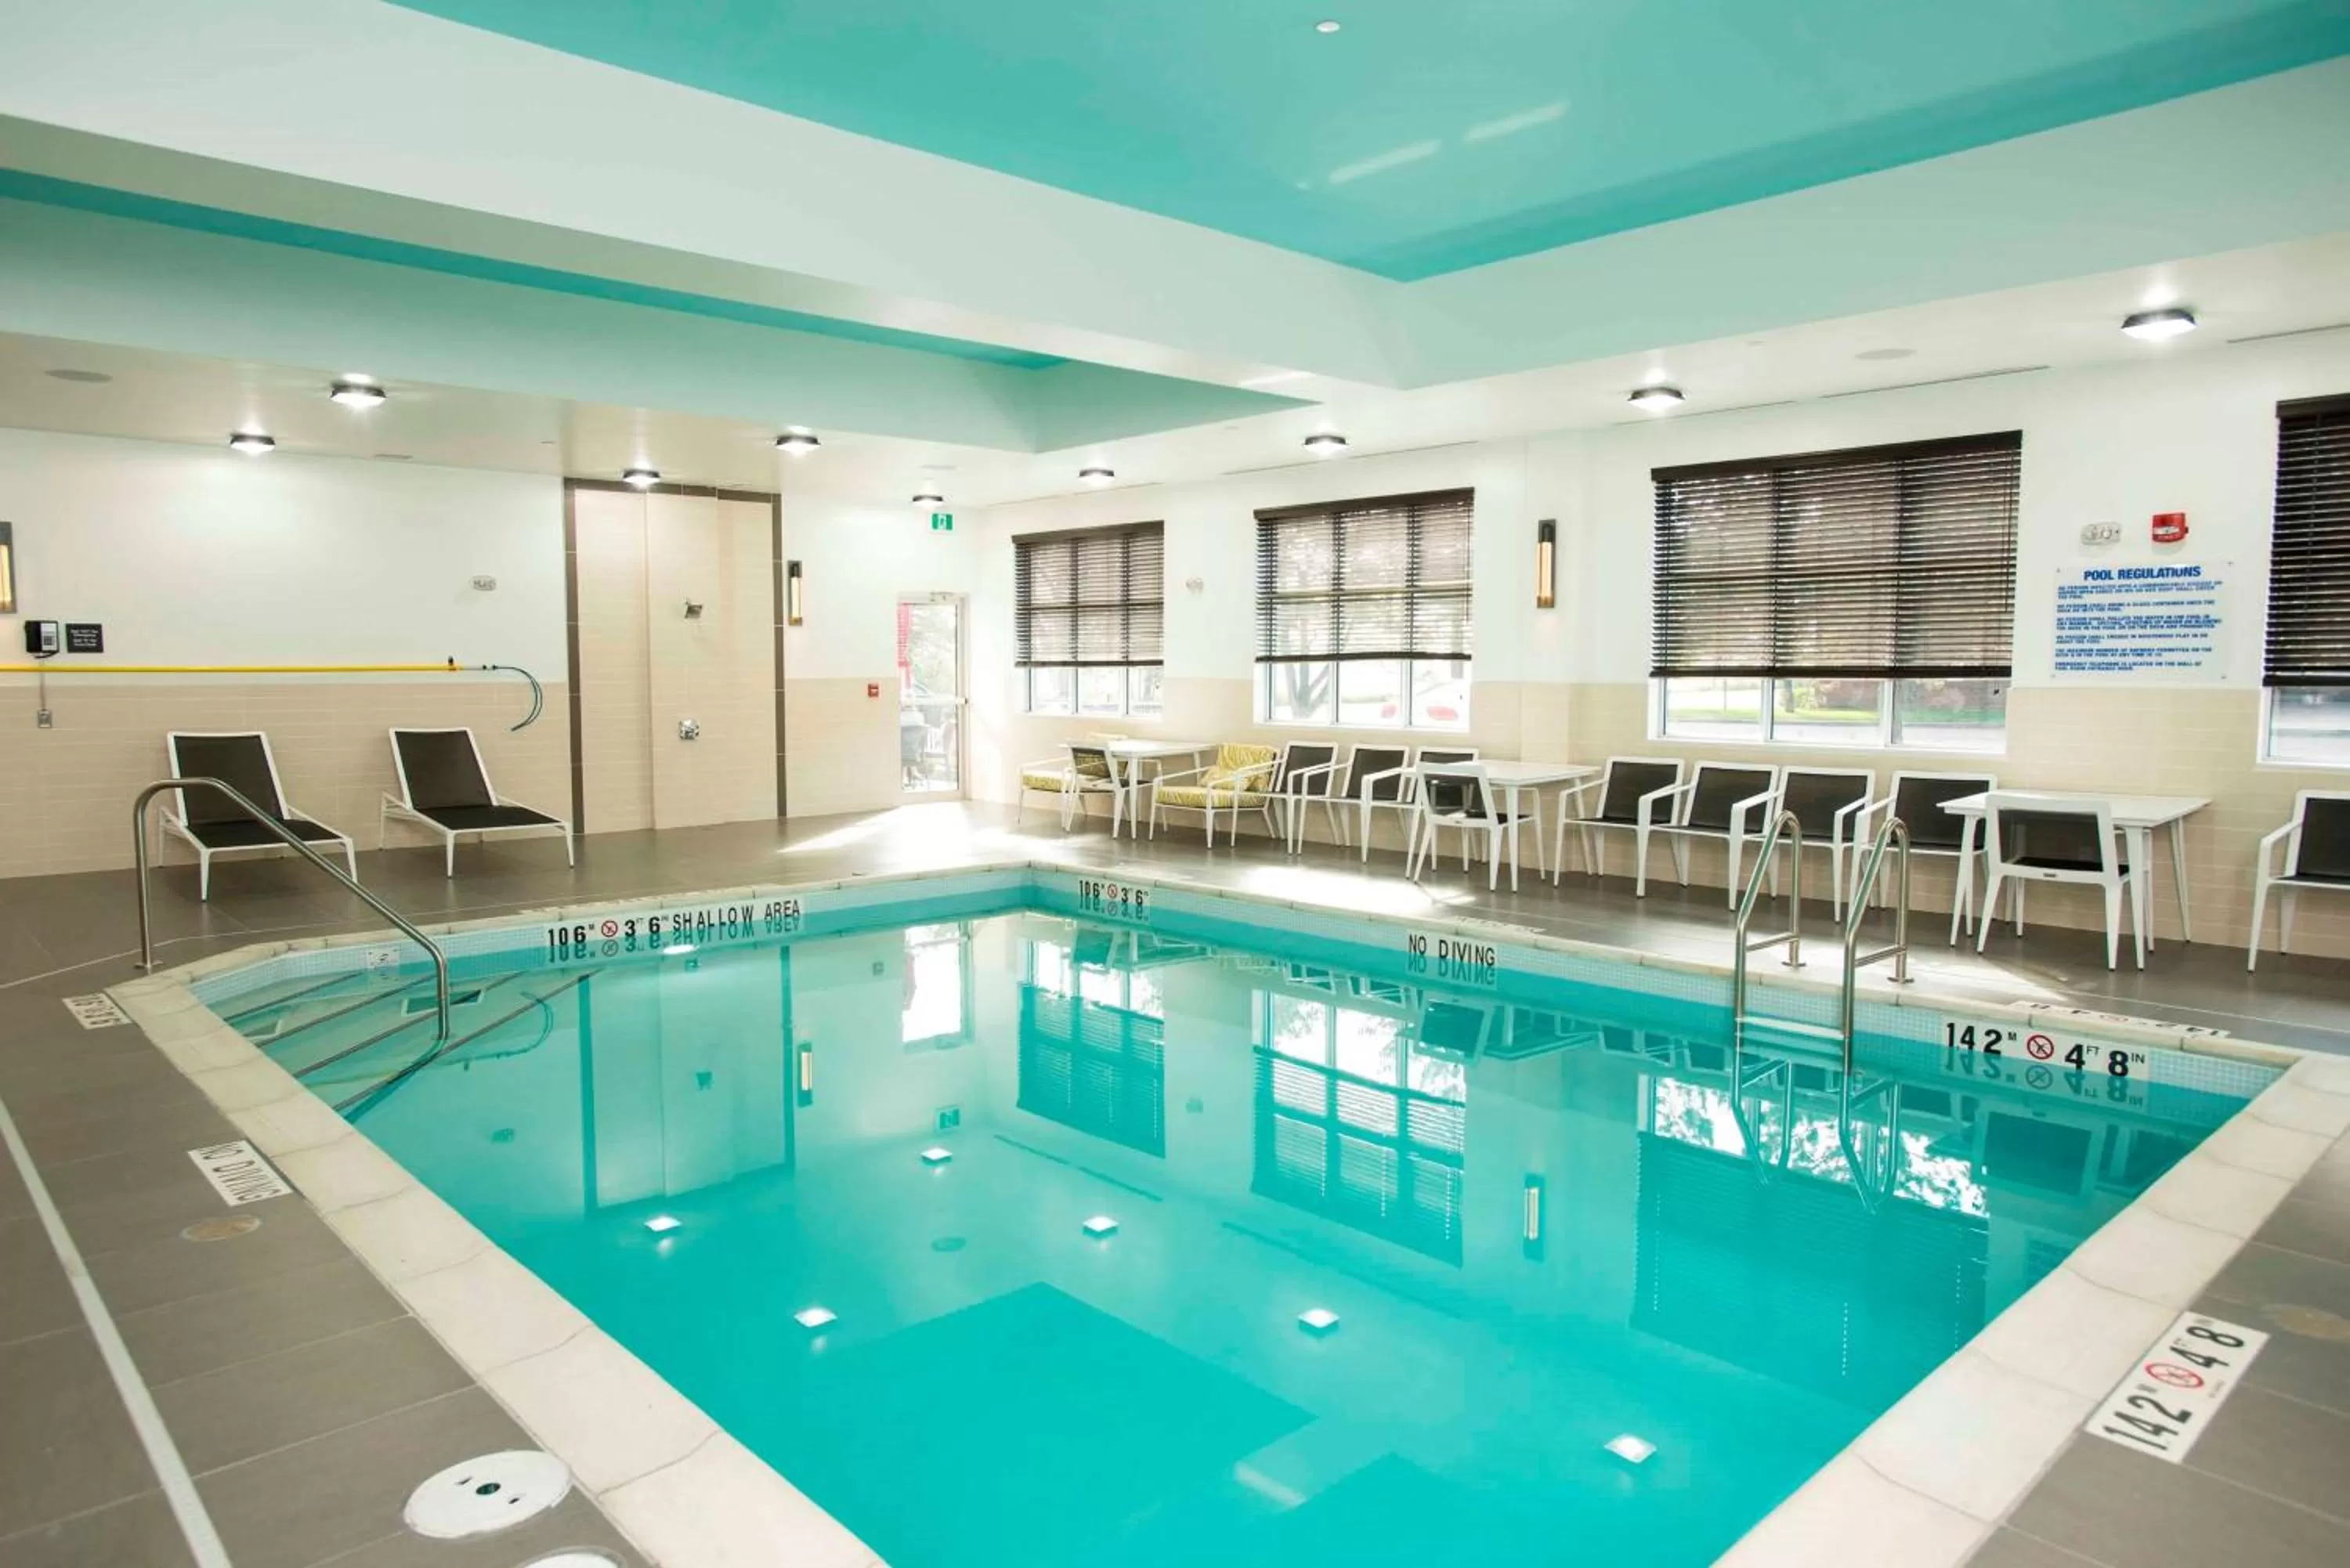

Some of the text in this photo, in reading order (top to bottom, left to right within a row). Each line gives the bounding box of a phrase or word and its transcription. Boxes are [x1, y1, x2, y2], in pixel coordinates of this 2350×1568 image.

[2084, 566, 2201, 580] POOL REGULATIONS
[625, 919, 635, 937] 3
[649, 916, 660, 934] 6
[673, 905, 754, 932] SHALLOW
[765, 899, 800, 920] AREA
[1409, 934, 1495, 966] NO DIVING
[2065, 1043, 2085, 1071] 4
[2108, 1050, 2128, 1076] 8
[2131, 1053, 2146, 1064] IN
[212, 1160, 281, 1201] DIVING
[2186, 1325, 2245, 1348] 8
[2169, 1346, 2230, 1368] 4
